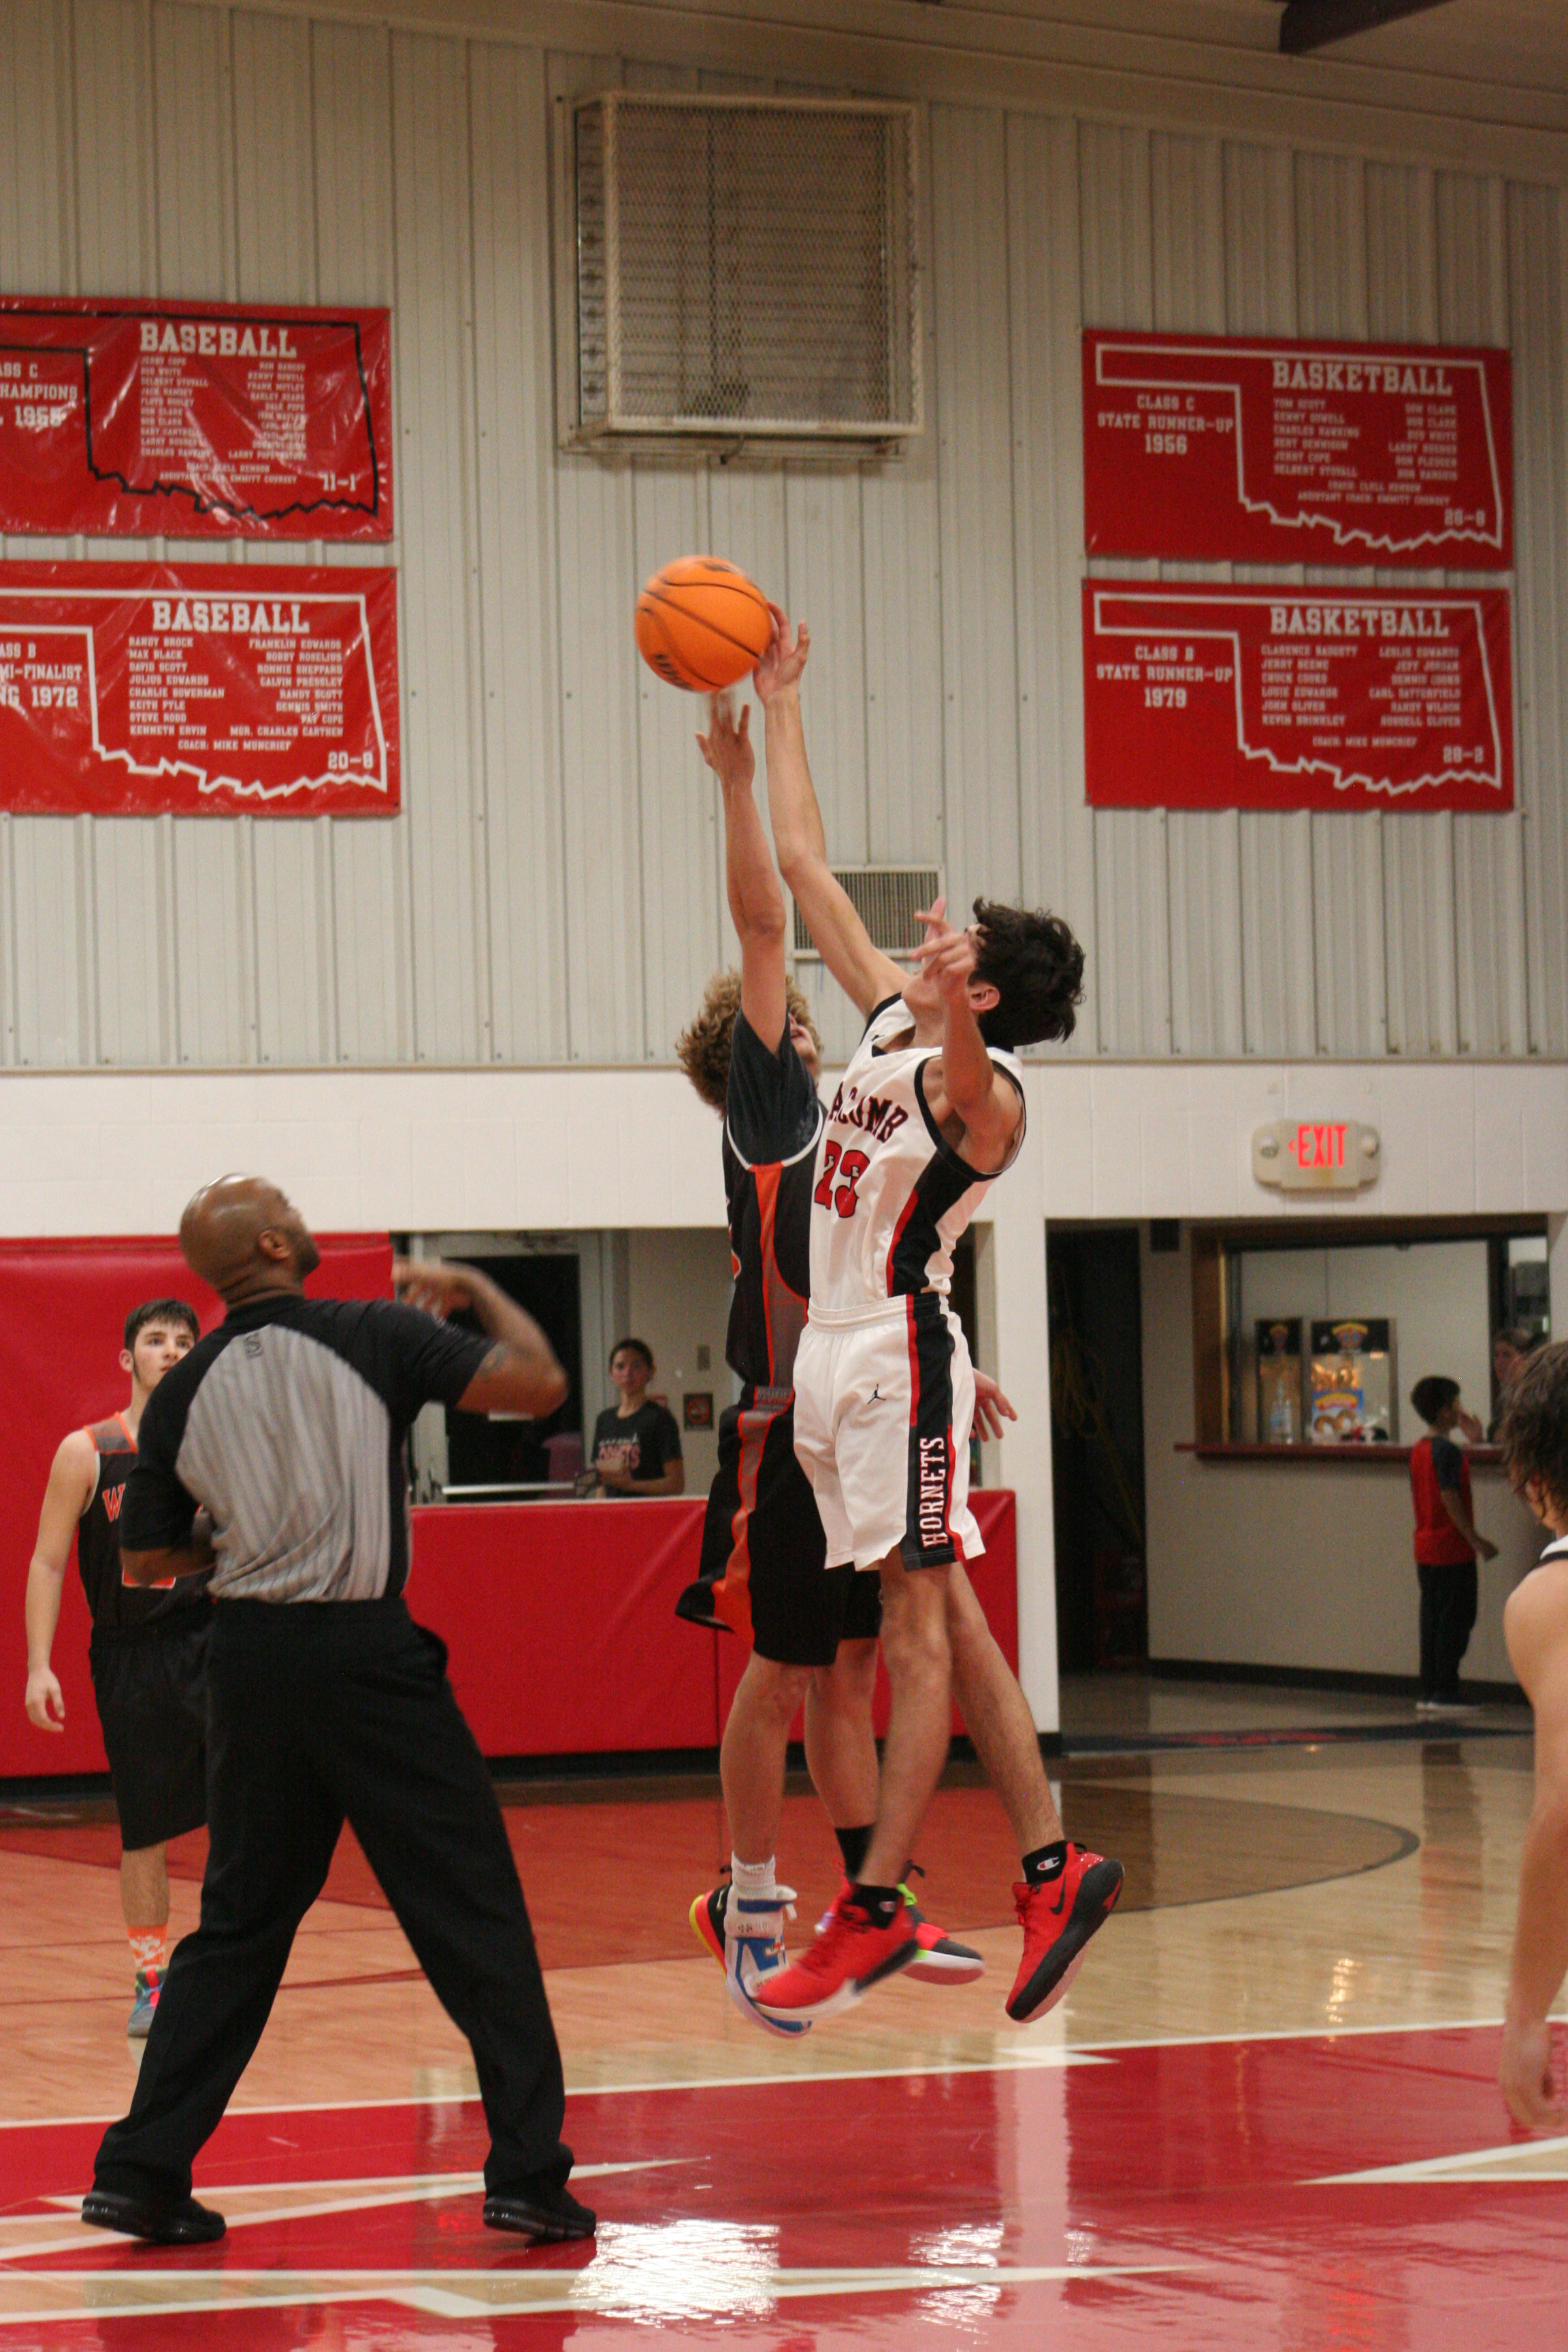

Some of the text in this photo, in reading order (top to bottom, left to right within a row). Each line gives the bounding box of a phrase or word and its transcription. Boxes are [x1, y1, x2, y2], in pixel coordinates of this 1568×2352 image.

[140, 323, 297, 358] BASEBALL
[29, 363, 39, 378] C
[1273, 360, 1454, 397] BASKETBALL
[1137, 394, 1194, 411] CLASS C
[1098, 412, 1234, 433] STATE RUNNER-UP
[152, 601, 310, 634] BASEBALL
[1270, 607, 1449, 638] BASKETBALL
[129, 636, 159, 647] RANDY
[249, 638, 342, 650] FRANKLIN EDWARDS
[27, 642, 36, 659] B
[129, 649, 183, 659] MAX BLACK
[1135, 645, 1194, 662] CLASS B
[129, 662, 154, 672] DAVID
[1096, 664, 1232, 683] STATE RUNNER-UP
[166, 674, 209, 685] EDWARDS
[260, 676, 292, 687] CALVIN
[31, 685, 79, 708] 1972
[129, 687, 168, 698] CHARLIE
[1145, 687, 1187, 708] 1979
[129, 700, 158, 710] KEITH
[130, 725, 175, 736] KENNETH
[1297, 1124, 1348, 1169] EXIT
[814, 1139, 870, 1218] 23
[919, 1437, 949, 1549] HORNETS
